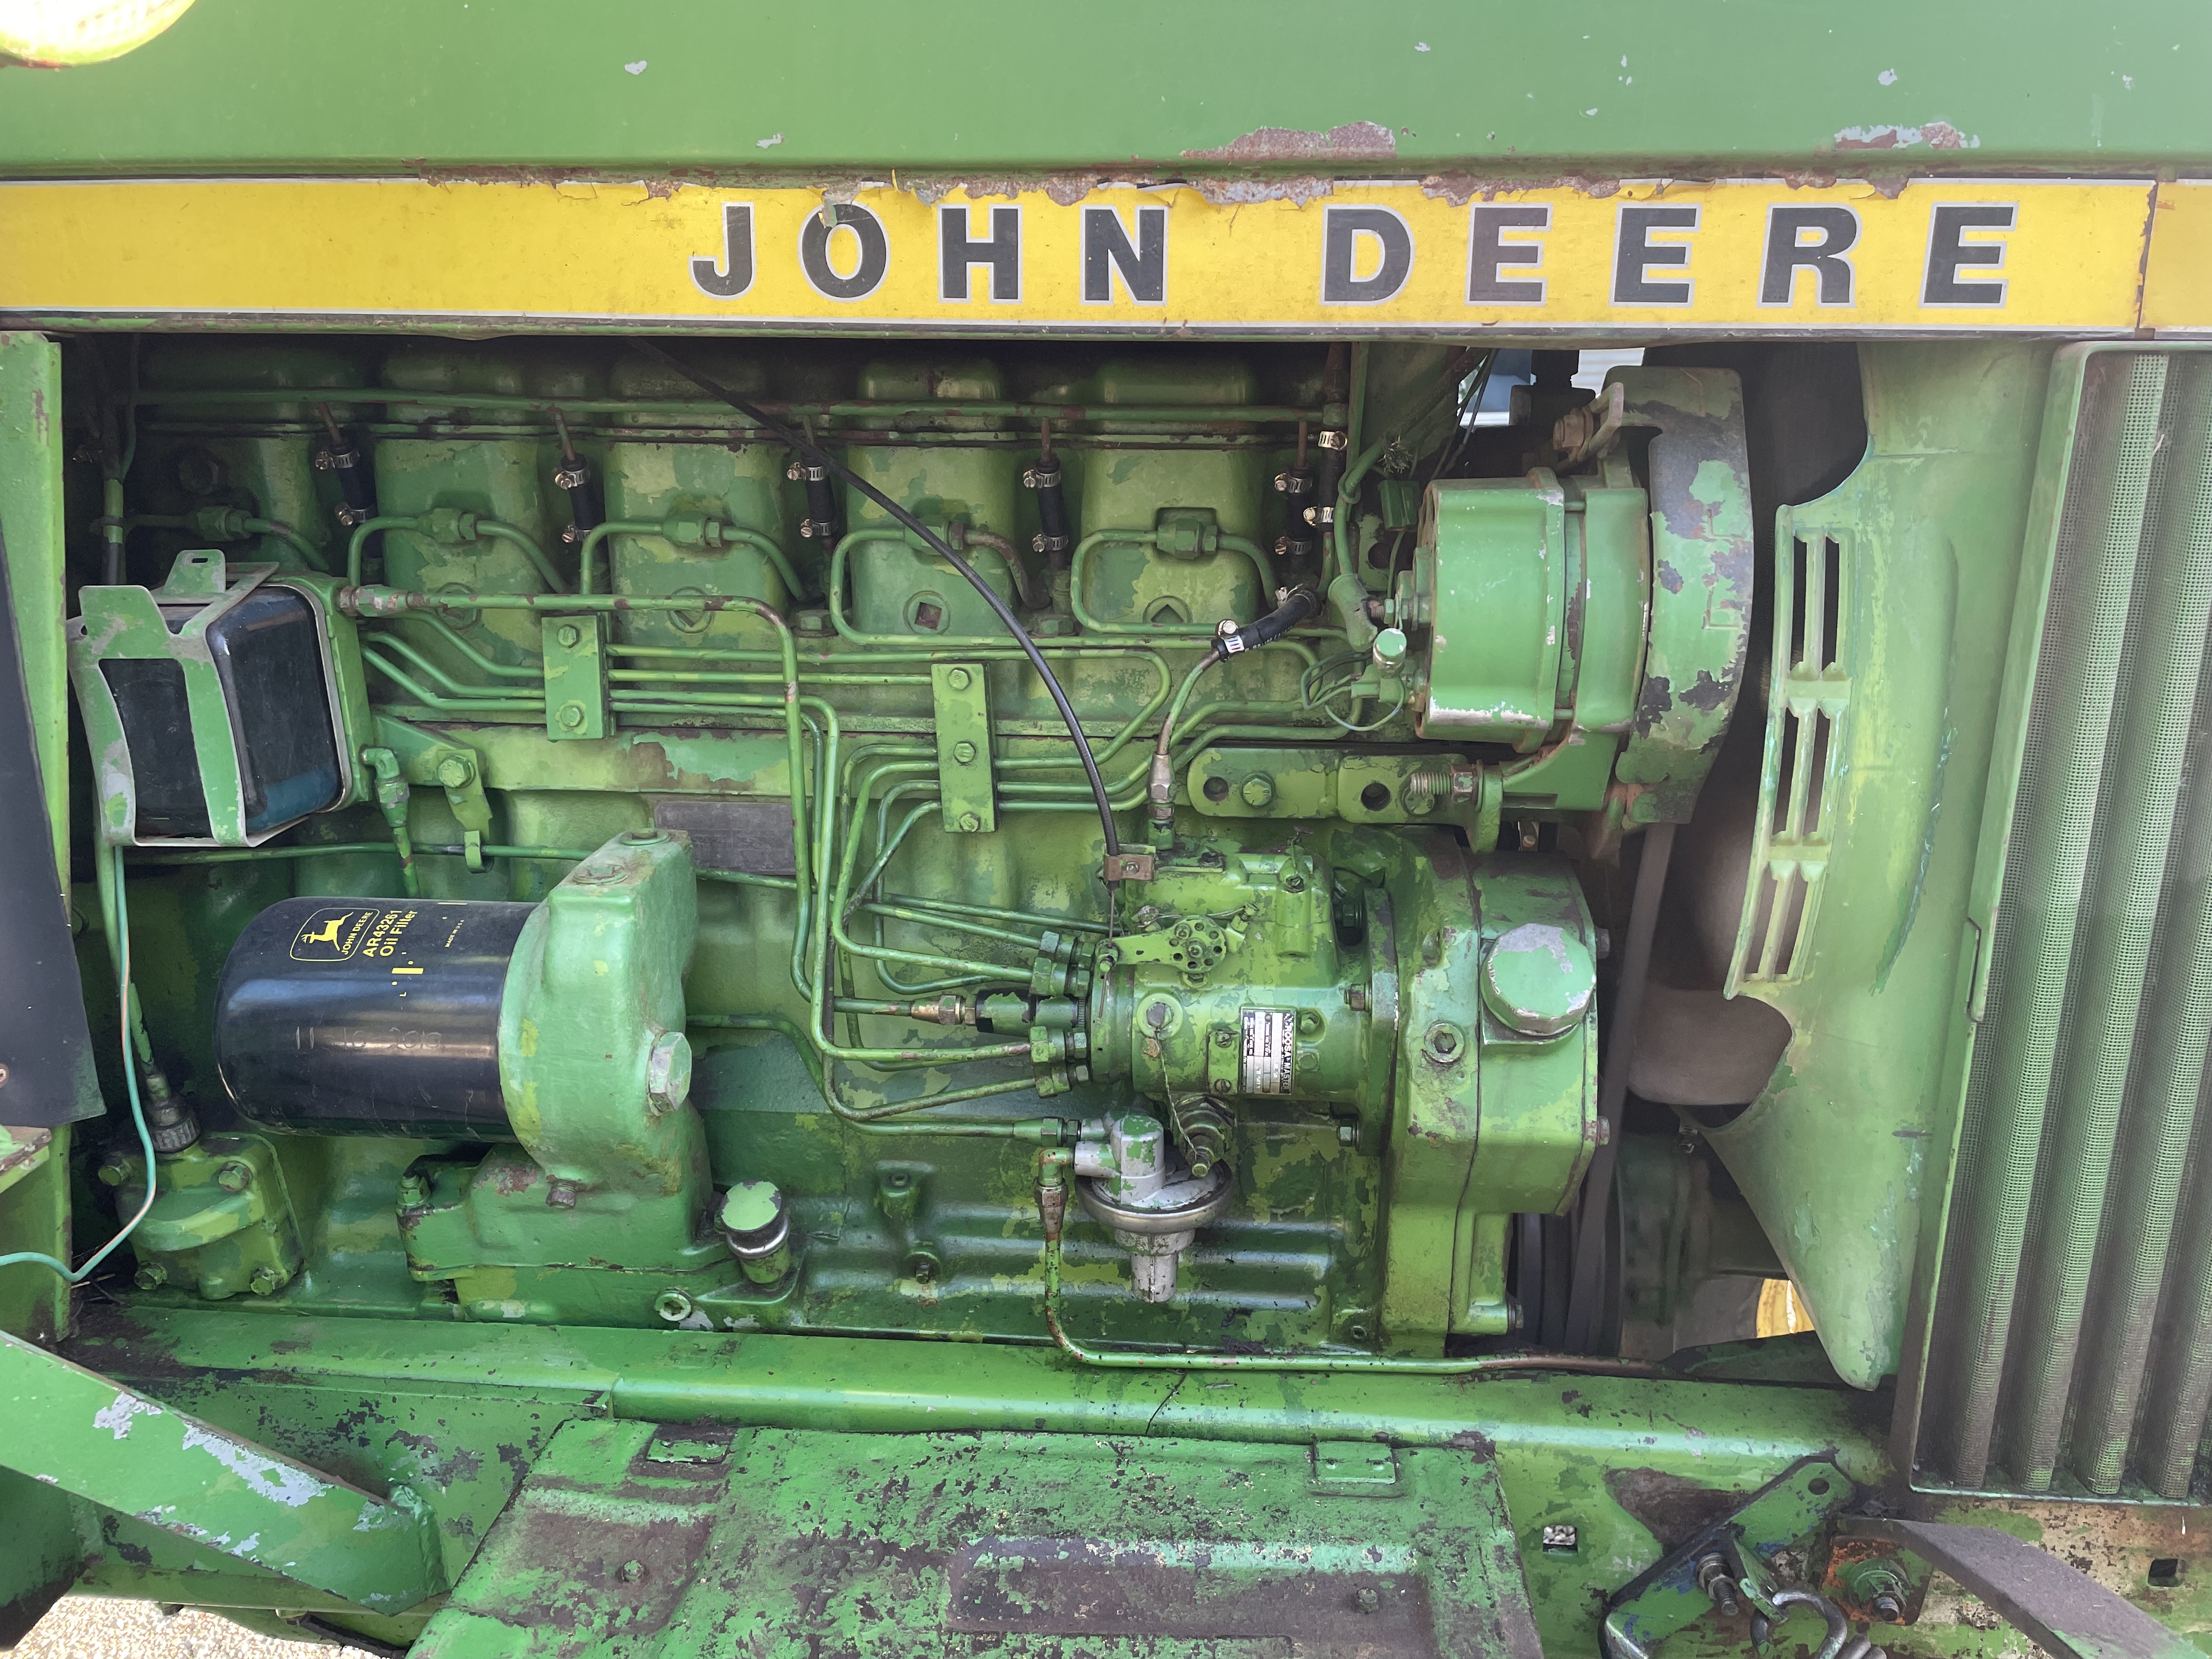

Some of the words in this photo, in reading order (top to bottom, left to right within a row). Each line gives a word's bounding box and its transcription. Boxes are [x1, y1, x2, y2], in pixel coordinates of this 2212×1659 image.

[690, 202, 1169, 306] JOHN
[1319, 202, 2020, 308] DEERE
[341, 933, 357, 955] JOHN
[352, 912, 374, 932] DEERE
[363, 911, 402, 957] AR43261
[380, 938, 399, 956] Oil
[390, 911, 418, 934] Filter
